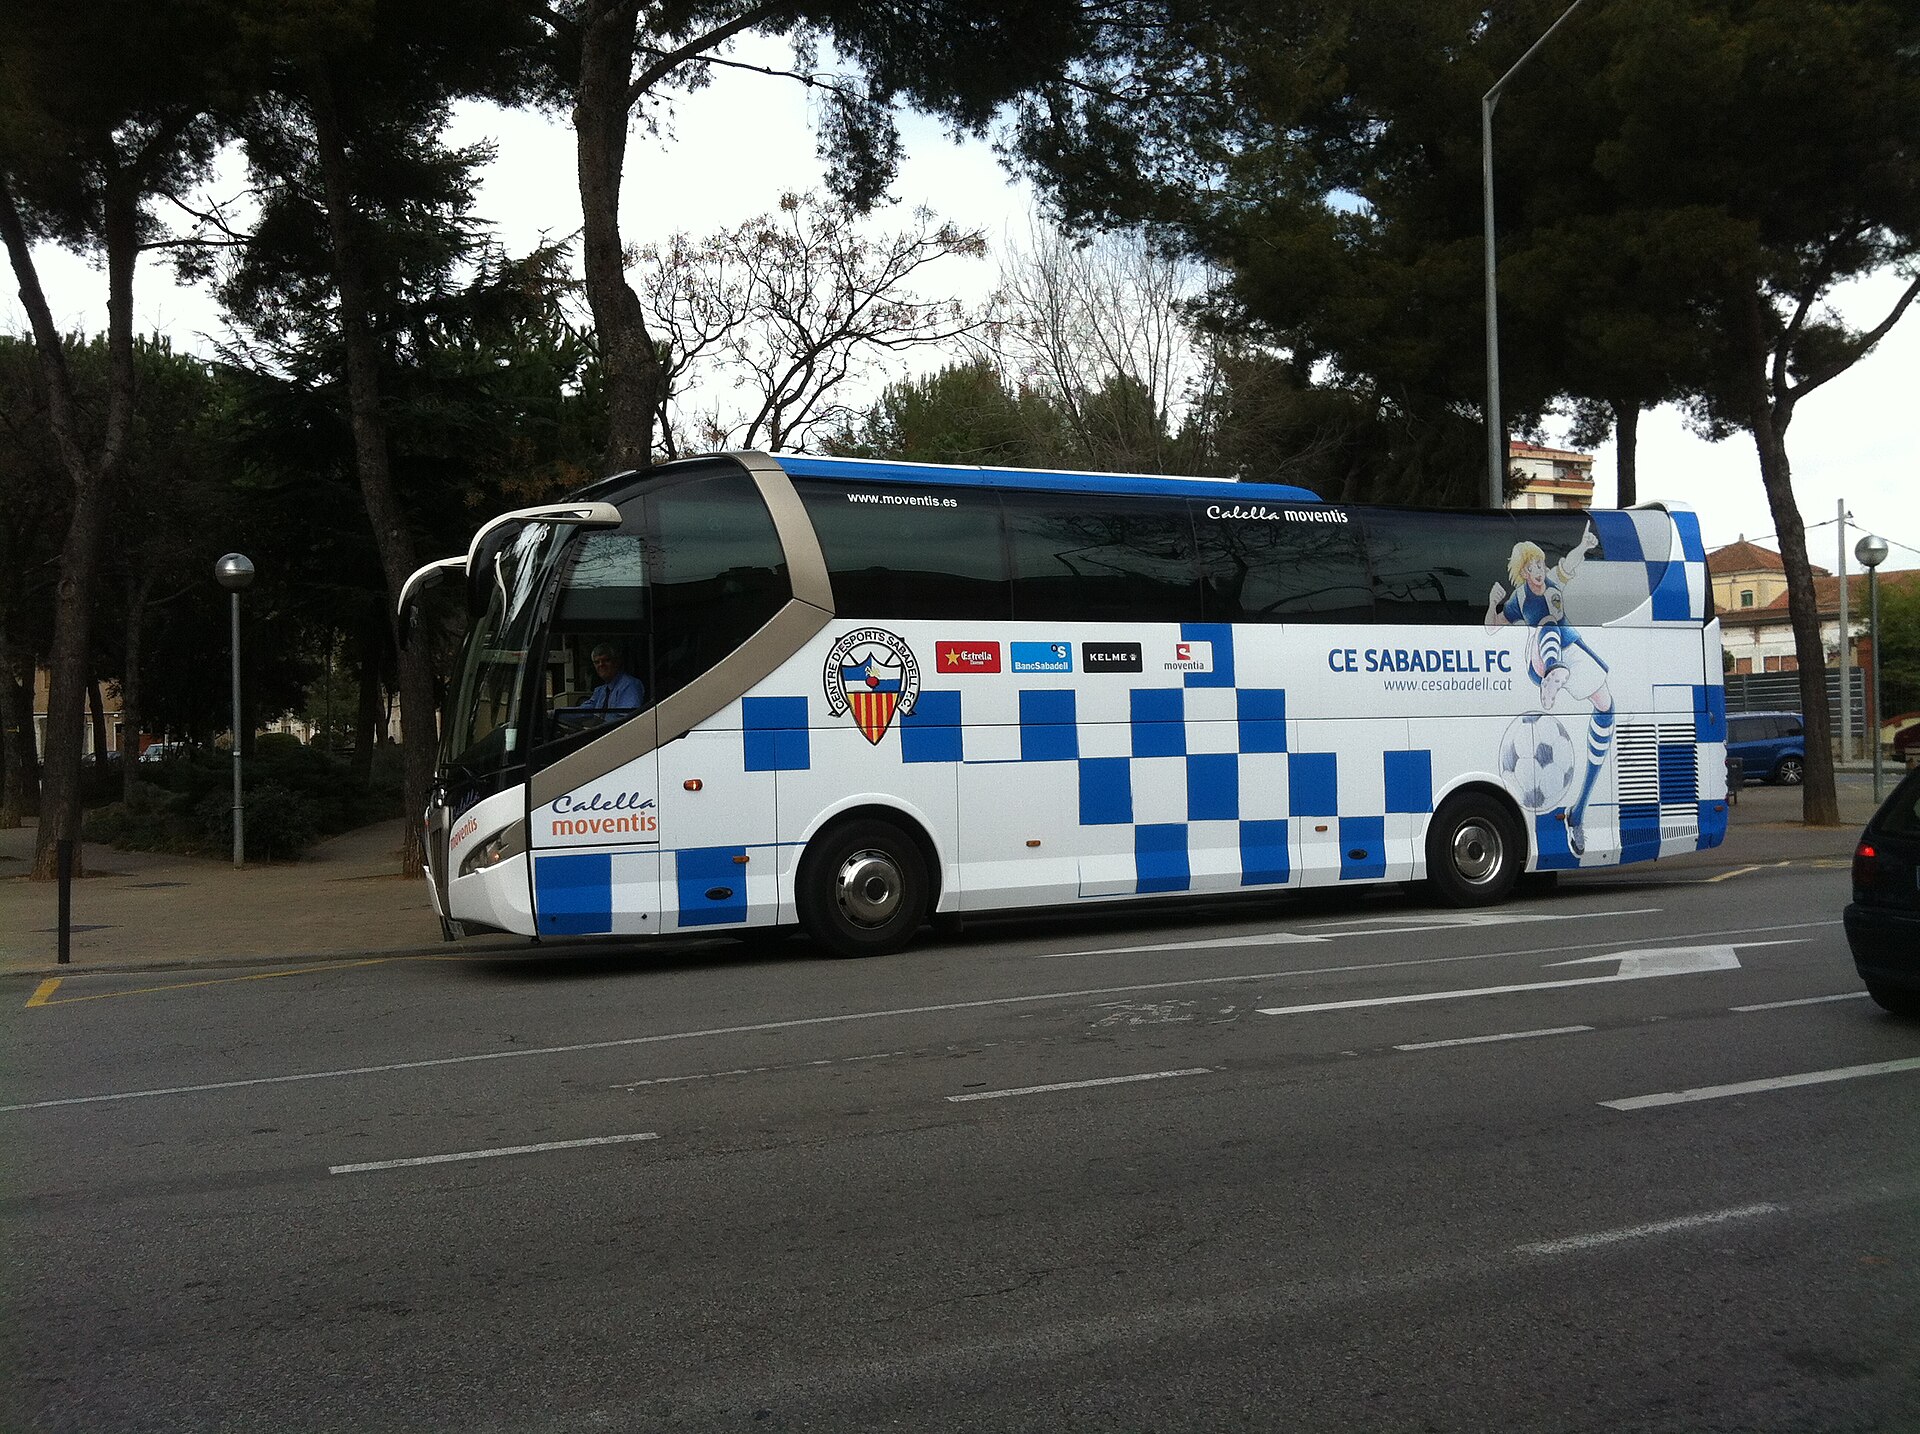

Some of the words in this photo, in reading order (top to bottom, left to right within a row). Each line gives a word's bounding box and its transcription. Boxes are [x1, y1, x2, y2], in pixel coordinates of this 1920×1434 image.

[847, 493, 958, 507] www.moventis.es
[1206, 505, 1280, 520] Calella
[1284, 509, 1349, 523] moventis
[832, 631, 886, 662] D'ESPORTS
[961, 651, 992, 660] Estrella
[886, 636, 918, 689] SABADELL
[1015, 661, 1069, 670] BancSabadell
[1090, 653, 1127, 661] KELME
[1164, 661, 1204, 670] moventia
[1328, 649, 1358, 672] CE
[1365, 649, 1480, 672] SABADELL
[1485, 650, 1512, 673] FC
[827, 661, 845, 709] CENTRE
[1383, 677, 1512, 691] www.cesabadell.cat
[552, 792, 656, 813] Calella
[552, 811, 657, 836] moventis
[451, 816, 478, 851] moventis
